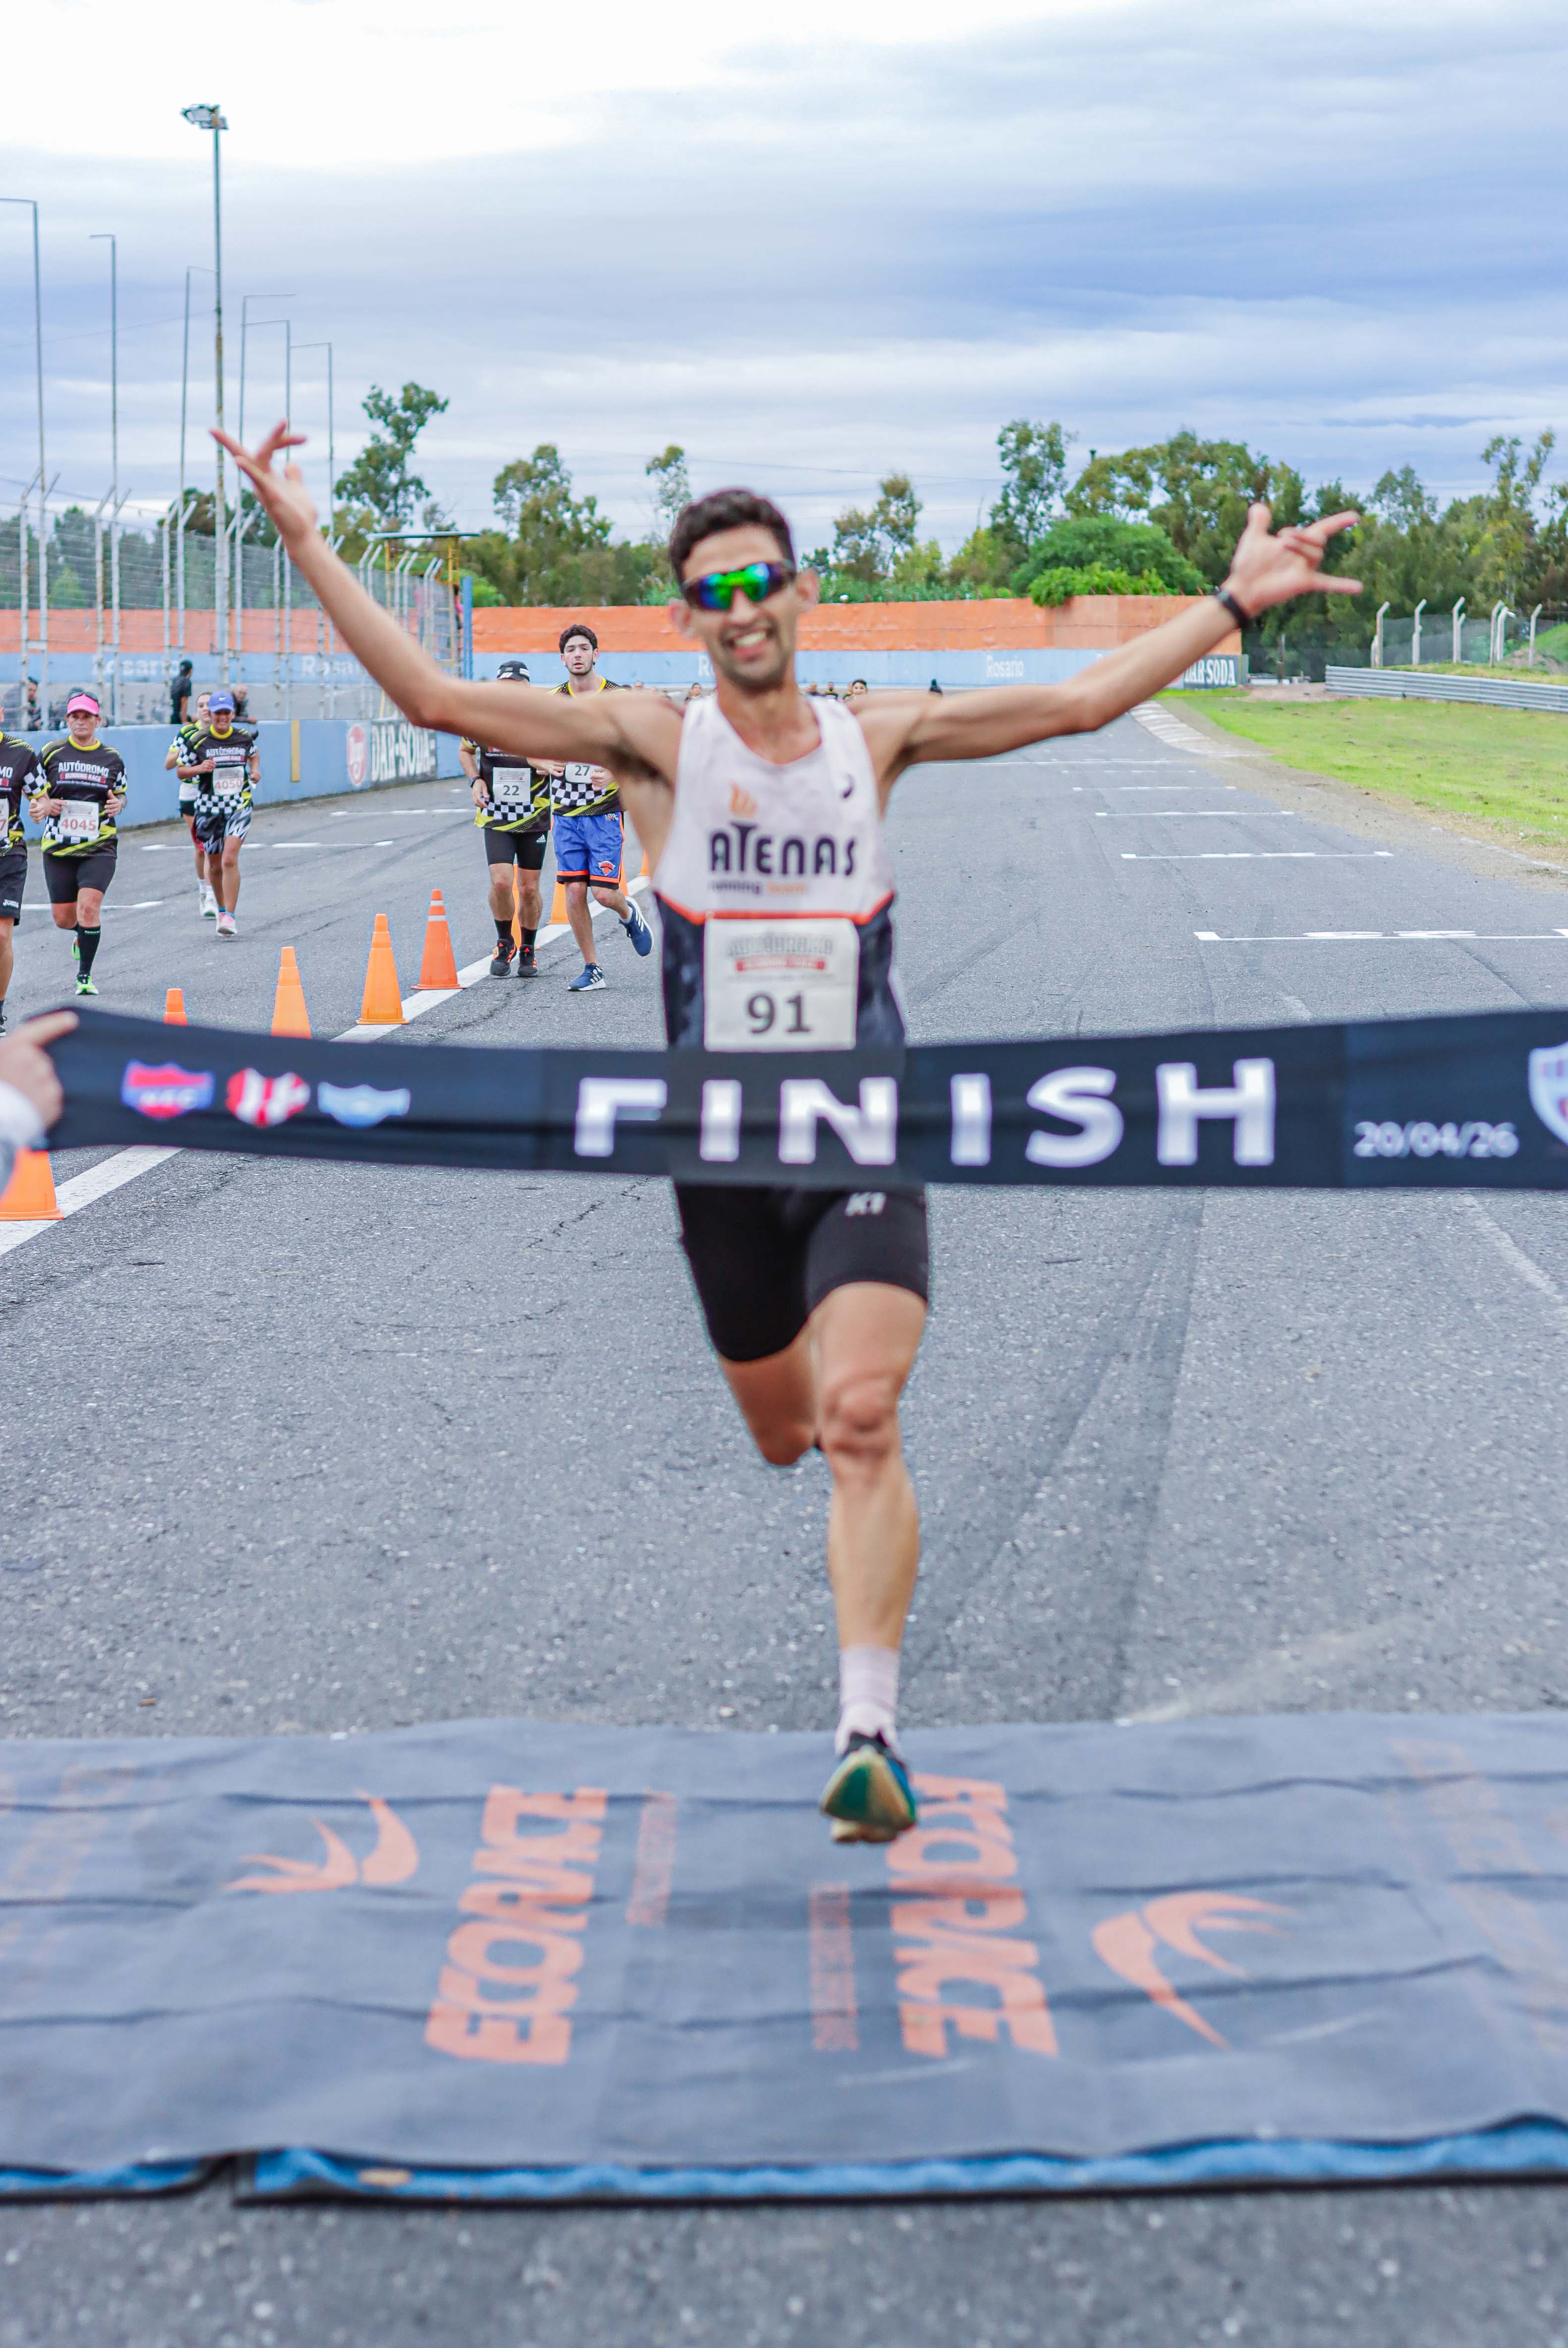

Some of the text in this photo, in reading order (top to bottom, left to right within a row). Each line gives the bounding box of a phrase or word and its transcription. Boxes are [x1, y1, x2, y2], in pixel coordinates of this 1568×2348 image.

[91, 654, 179, 677] osaro
[986, 654, 1024, 677] Rosario
[58, 760, 109, 778] AUTÓDROMO
[88, 774, 101, 783] RACE
[575, 765, 590, 776] 27
[214, 779, 242, 789] 4050
[503, 784, 520, 796] 22
[61, 818, 97, 831] 4045
[710, 821, 857, 877] ATENAS
[747, 993, 811, 1034] 91
[574, 1057, 1276, 1168] FINISH
[1353, 1121, 1519, 1158] 20/04/26
